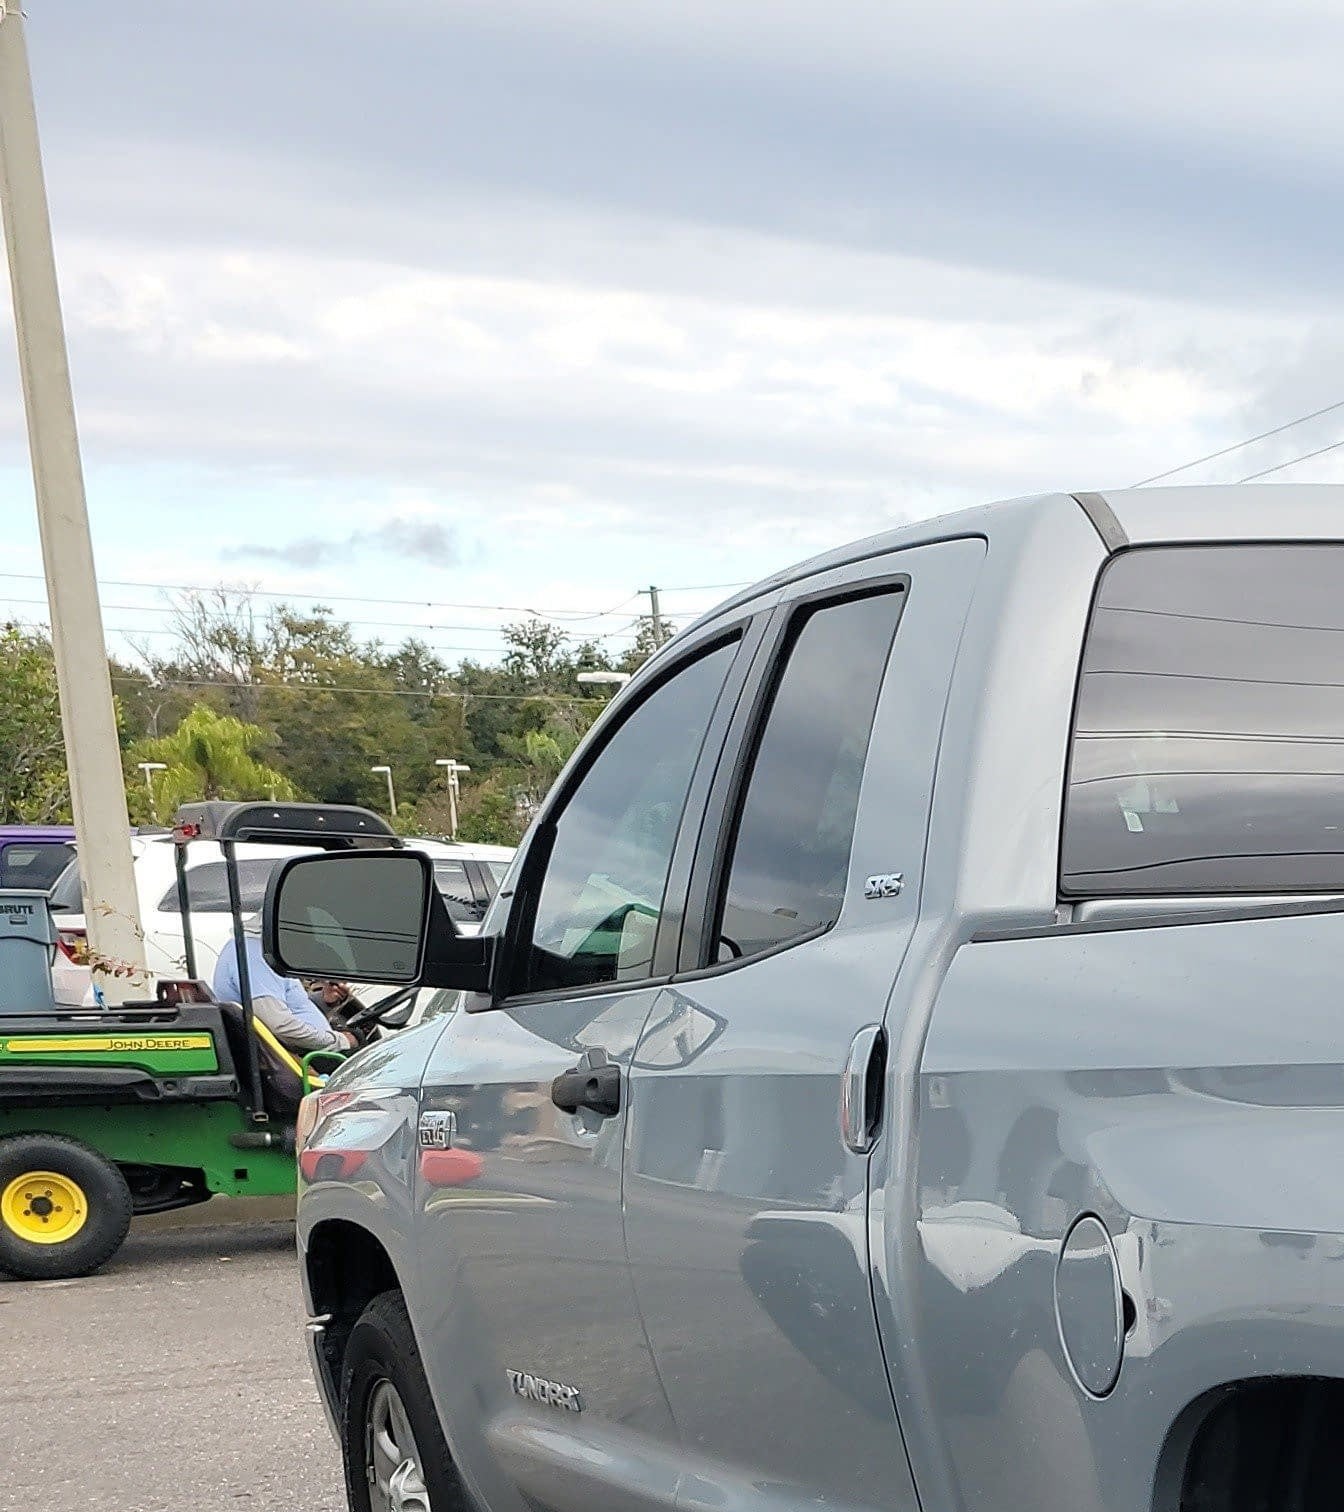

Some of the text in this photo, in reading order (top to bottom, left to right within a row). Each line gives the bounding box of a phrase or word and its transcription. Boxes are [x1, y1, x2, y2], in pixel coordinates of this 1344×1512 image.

[864, 872, 904, 899] SR5
[107, 1039, 190, 1049] JOHN DEERE
[506, 1368, 582, 1412] TUNDRA
